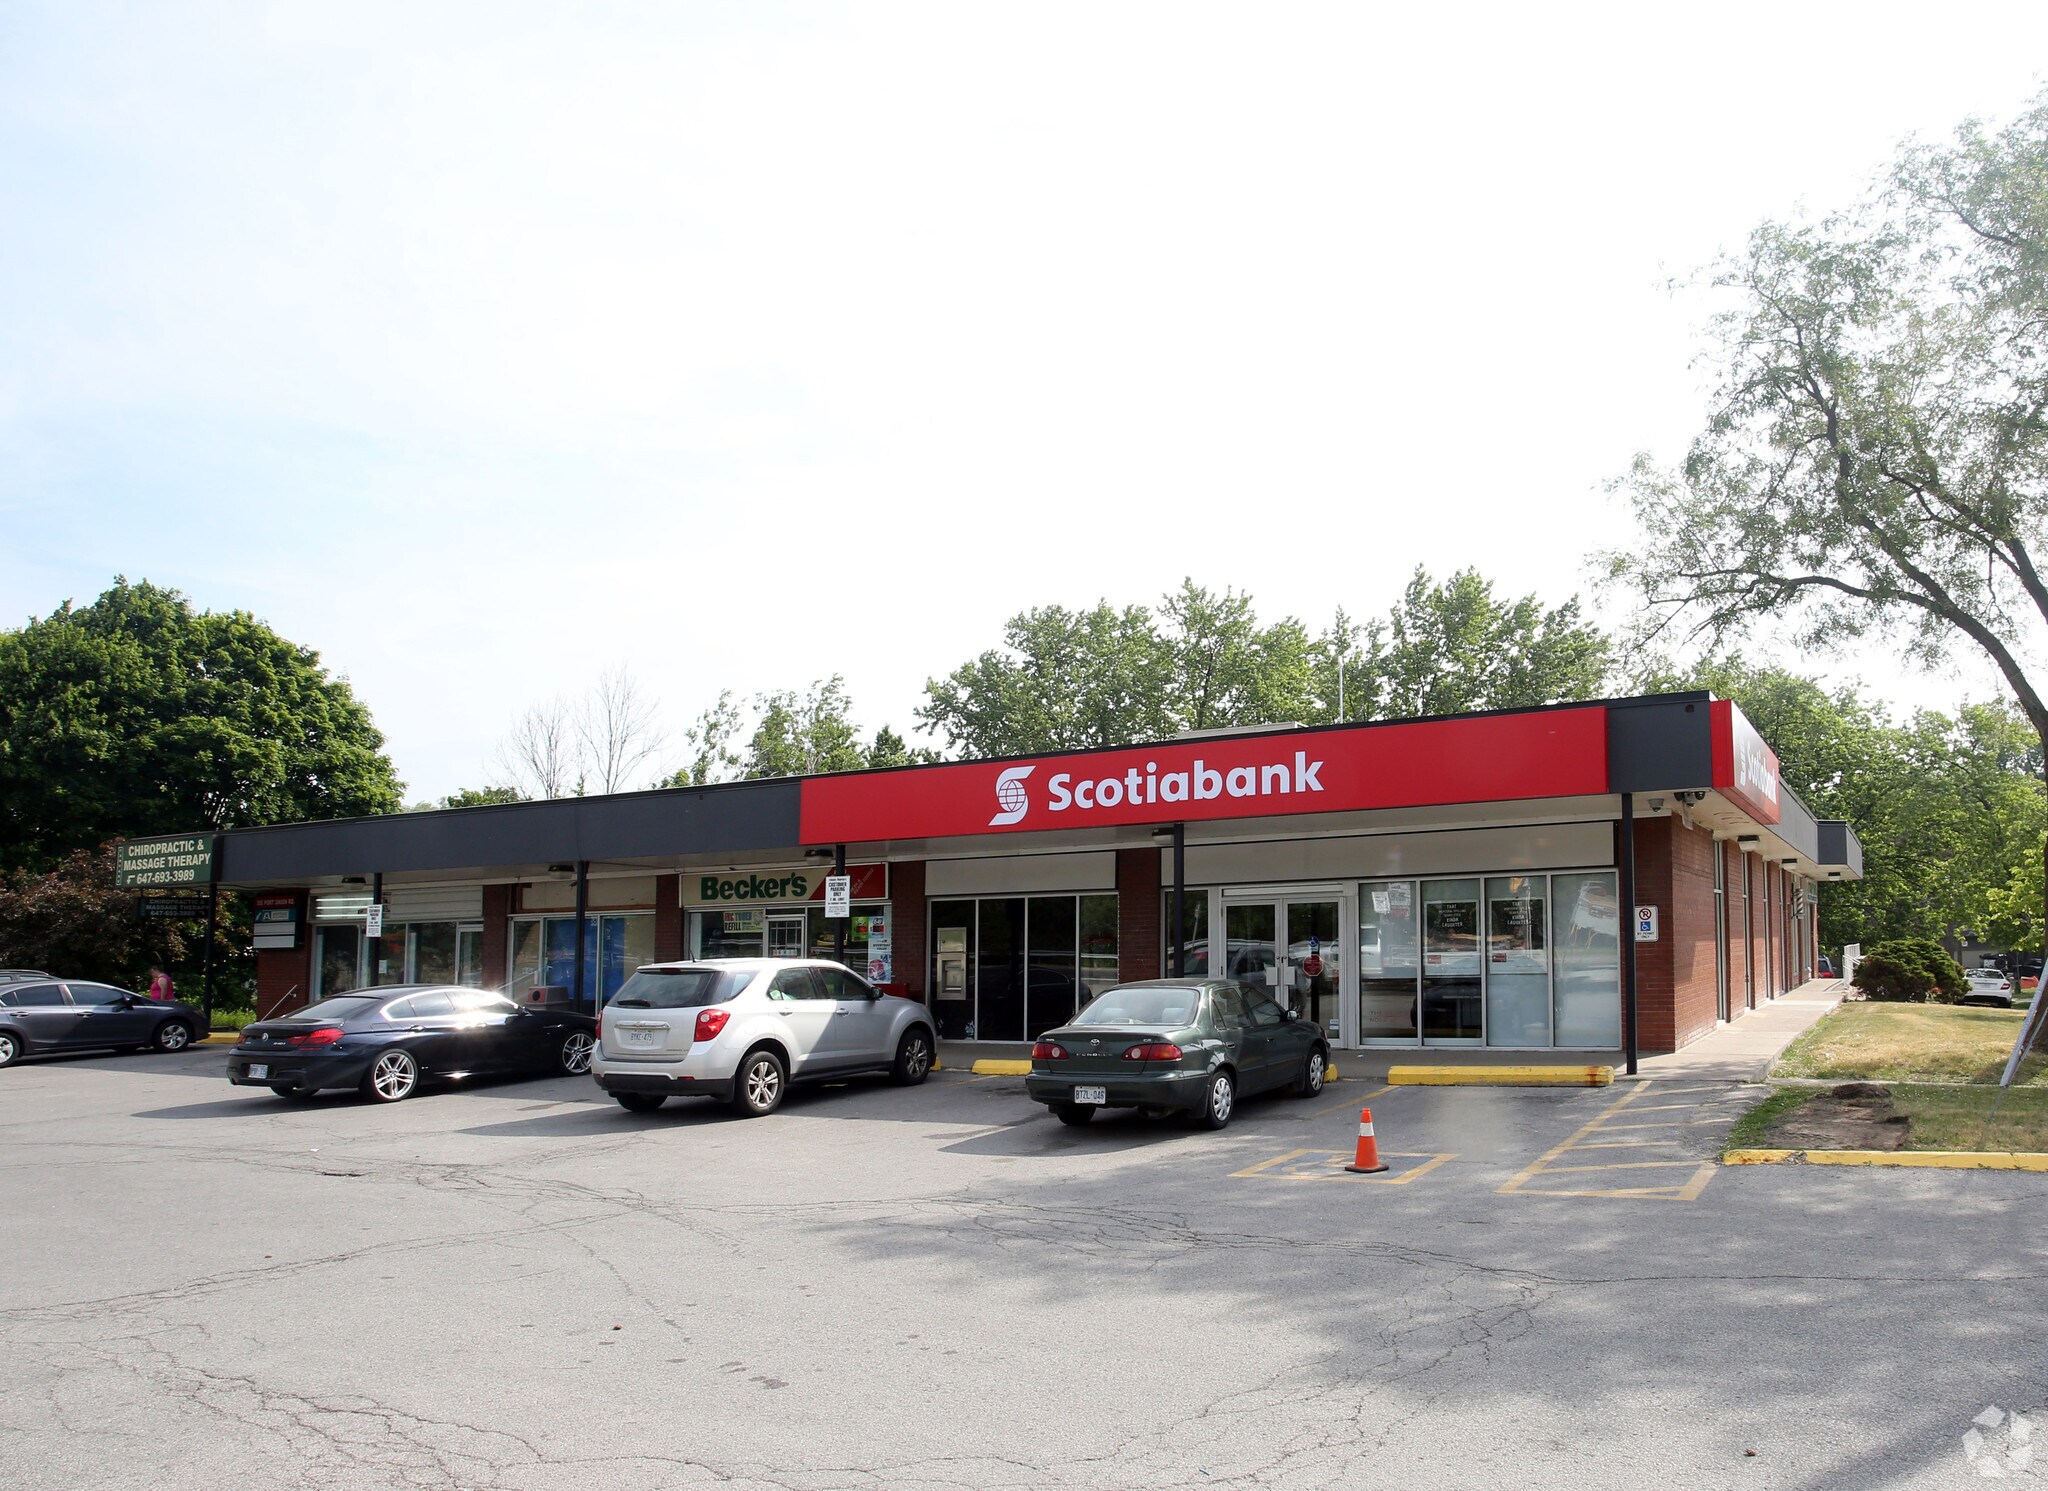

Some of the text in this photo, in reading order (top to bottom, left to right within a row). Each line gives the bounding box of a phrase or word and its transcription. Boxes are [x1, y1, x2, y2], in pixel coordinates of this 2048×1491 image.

[1047, 750, 1325, 812] Scotiabank
[128, 839, 204, 857] CHIROPRACTIC &
[123, 853, 211, 871] MASSAGE THERAPY
[136, 869, 195, 884] 647-693-3989
[700, 872, 808, 901] Becker's
